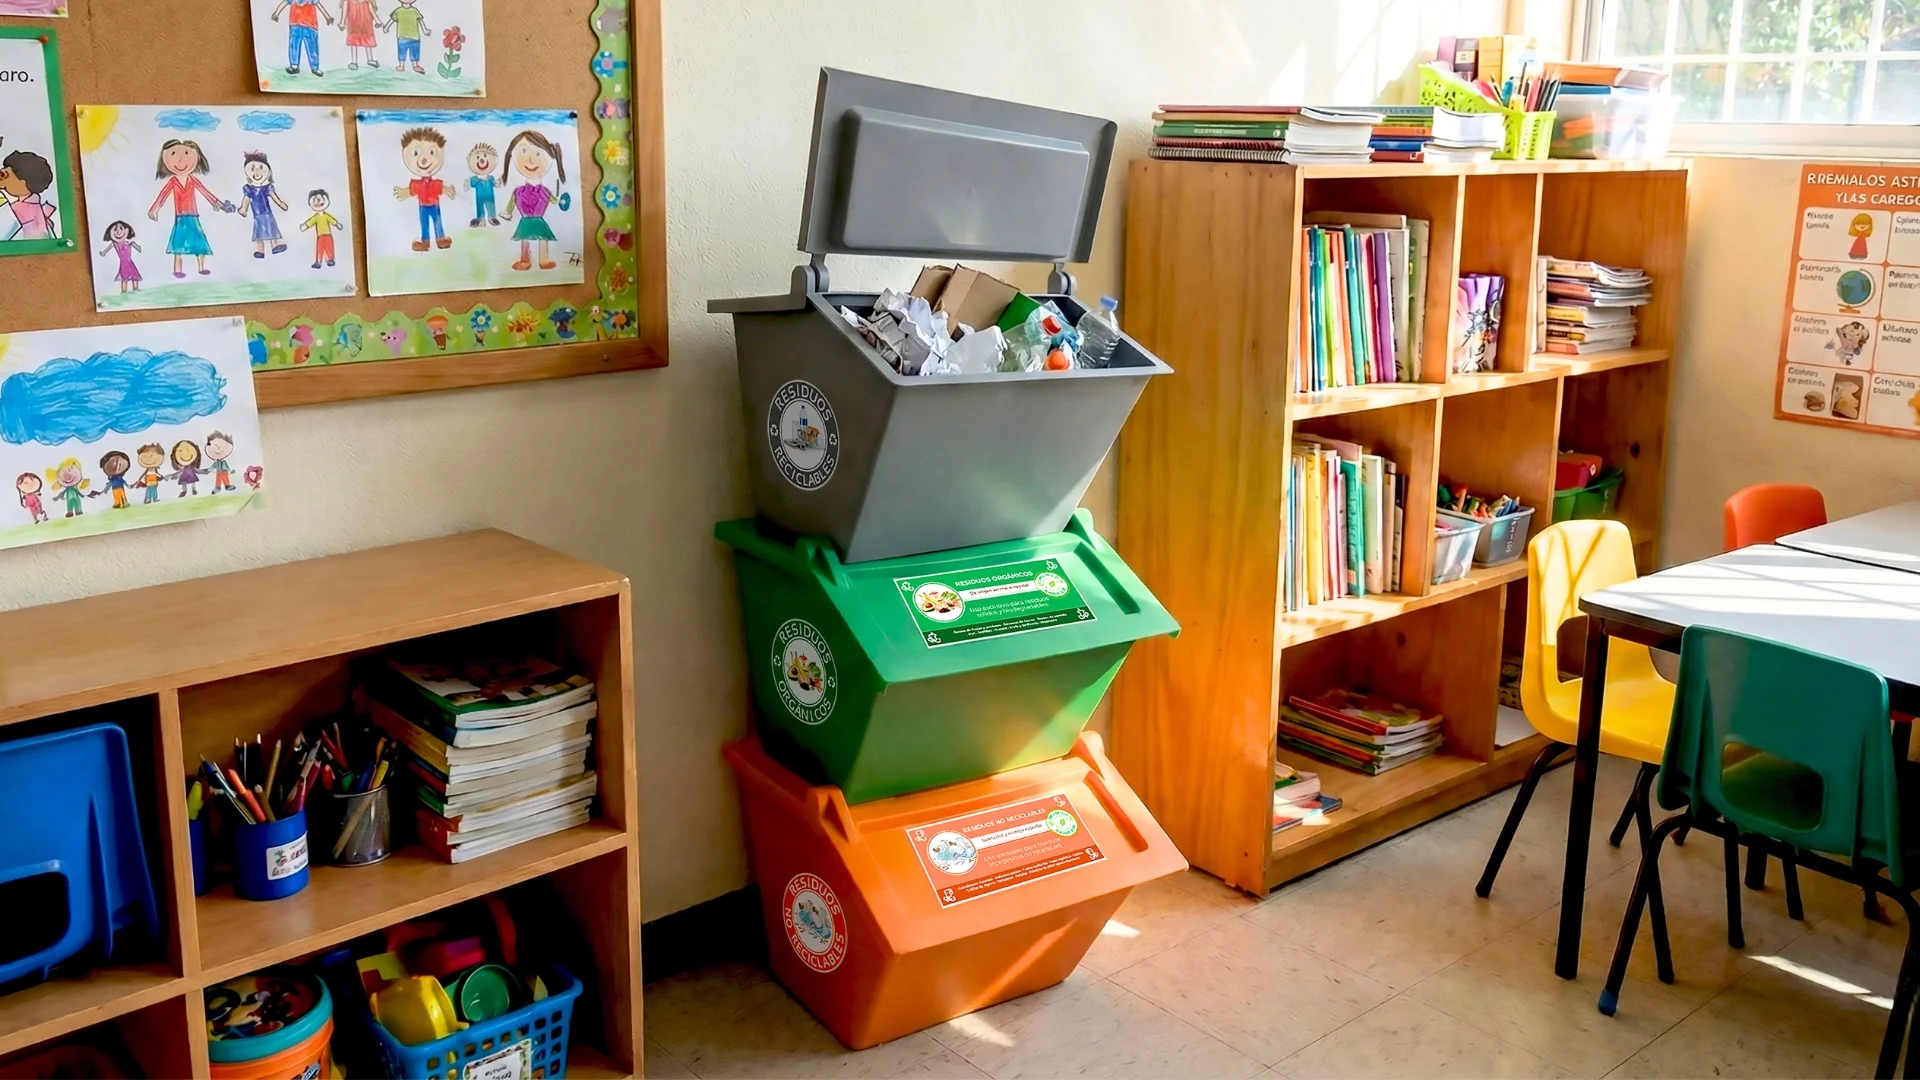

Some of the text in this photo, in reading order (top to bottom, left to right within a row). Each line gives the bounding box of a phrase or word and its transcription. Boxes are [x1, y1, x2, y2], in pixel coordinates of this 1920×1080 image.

[774, 384, 833, 421] RESIDUOS
[774, 446, 835, 487] RECICLABLES
[954, 571, 1034, 587] RESIDUOS ORGÁNICOS
[779, 623, 832, 665] RESIDUOS
[778, 680, 832, 721] ORGÁNICOS
[962, 821, 995, 833] RESIDUOS
[1005, 808, 1047, 823] RECICLABLES
[789, 877, 841, 916] RESIDUOS
[785, 907, 845, 969] NO RECICLABLES
